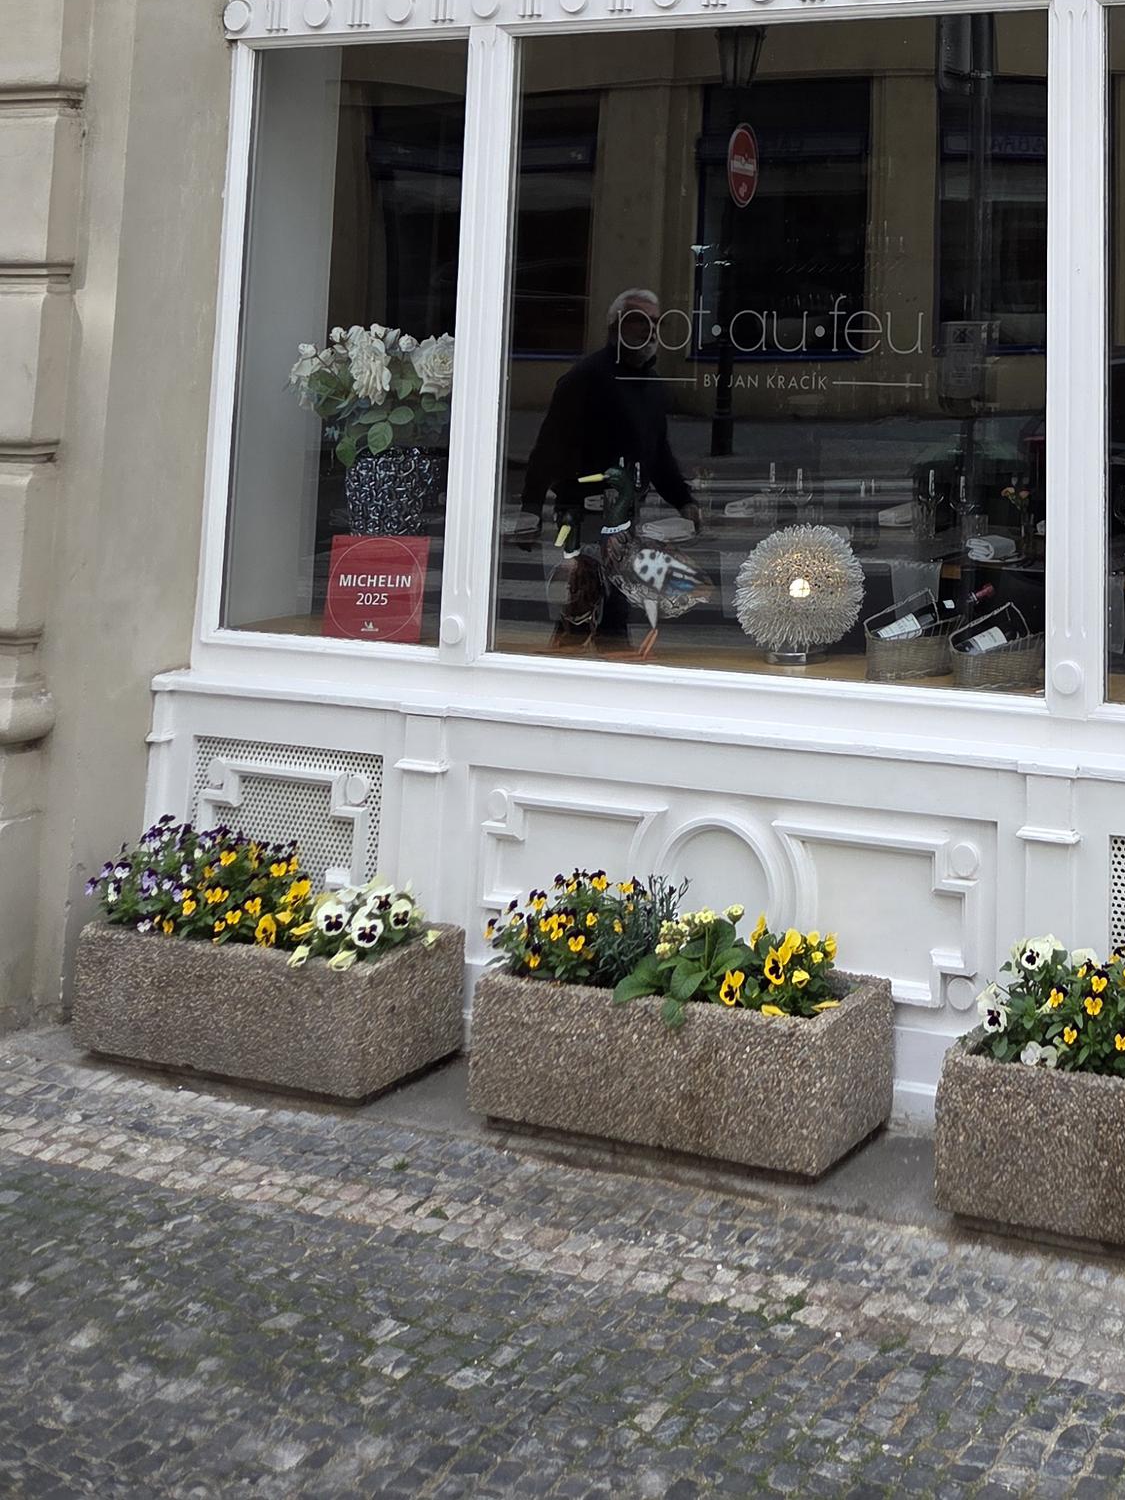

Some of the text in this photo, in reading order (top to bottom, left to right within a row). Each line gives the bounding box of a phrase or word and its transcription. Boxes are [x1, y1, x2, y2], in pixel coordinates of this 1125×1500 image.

[703, 372, 828, 390] BY JAN KRACÍK
[339, 574, 411, 588] MICHELIN
[356, 593, 389, 605] 2025
